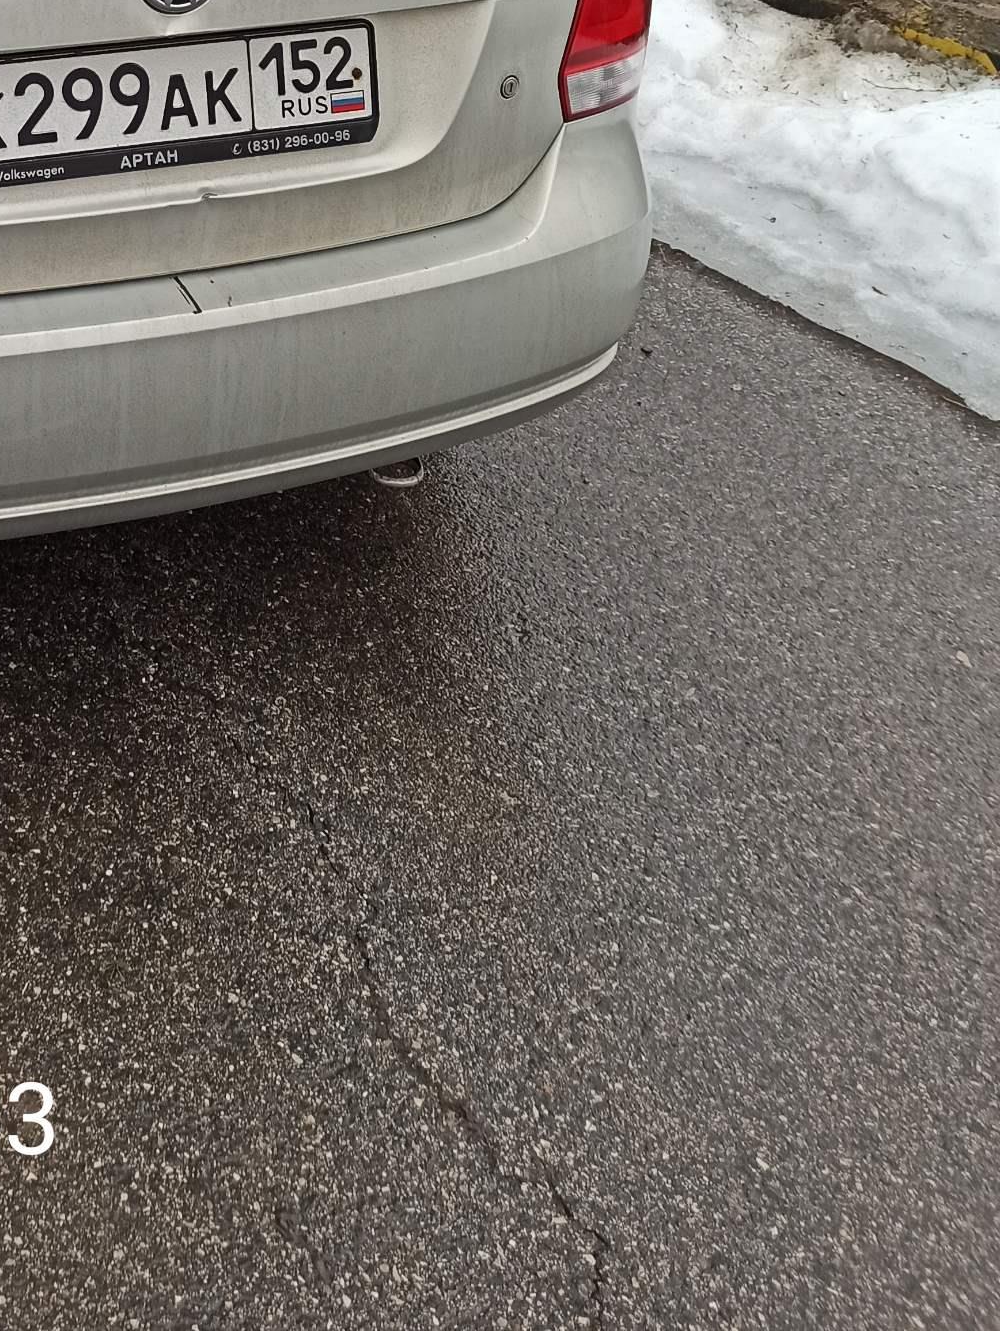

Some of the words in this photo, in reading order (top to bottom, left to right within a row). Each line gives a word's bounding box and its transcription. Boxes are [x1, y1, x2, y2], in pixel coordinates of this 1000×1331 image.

[258, 36, 354, 96] 152
[280, 95, 329, 118] RUS
[247, 137, 280, 154] (831)
[284, 128, 351, 149] 296-00-96
[119, 149, 179, 171] АРТАН
